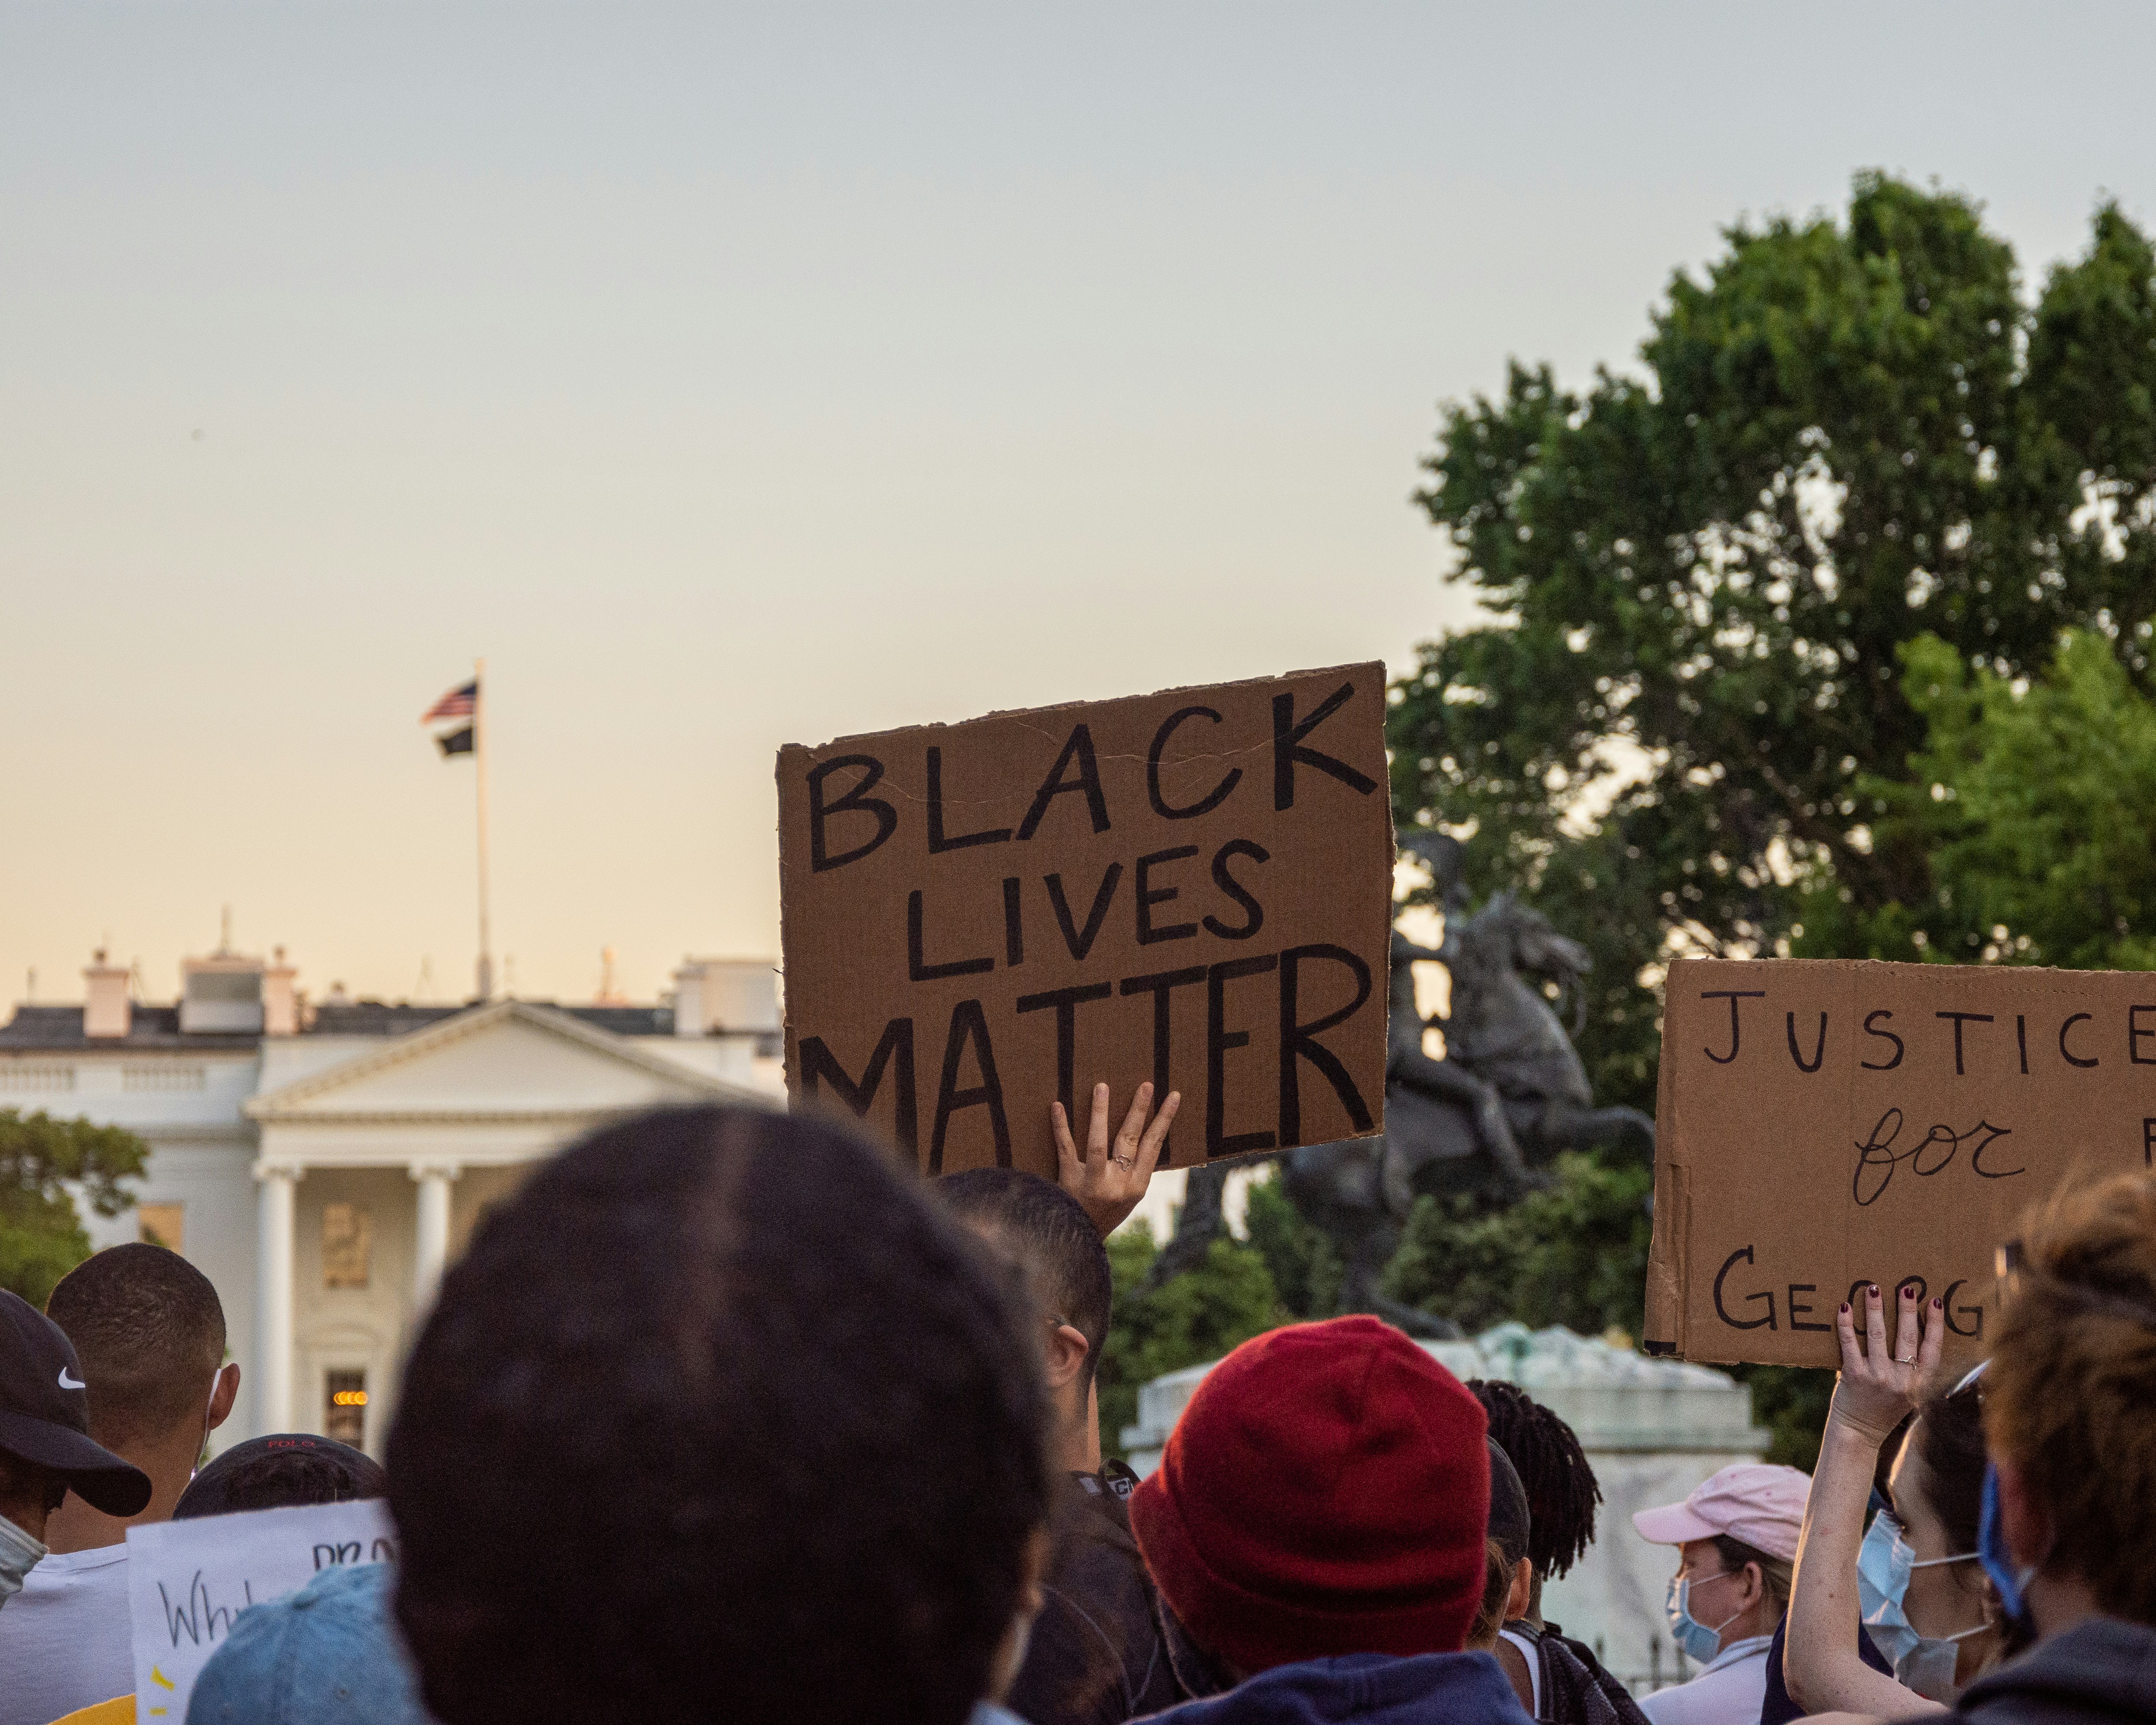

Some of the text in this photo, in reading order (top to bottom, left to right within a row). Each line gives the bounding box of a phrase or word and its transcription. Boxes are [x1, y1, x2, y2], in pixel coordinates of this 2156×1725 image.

[806, 682, 1378, 872] BLACK
[908, 839, 1270, 981] LIVES
[799, 944, 1374, 1177] MATTER
[1701, 990, 2156, 1075] JUSTICE
[1853, 1108, 2026, 1206] for
[1713, 1245, 2000, 1341] GEORG
